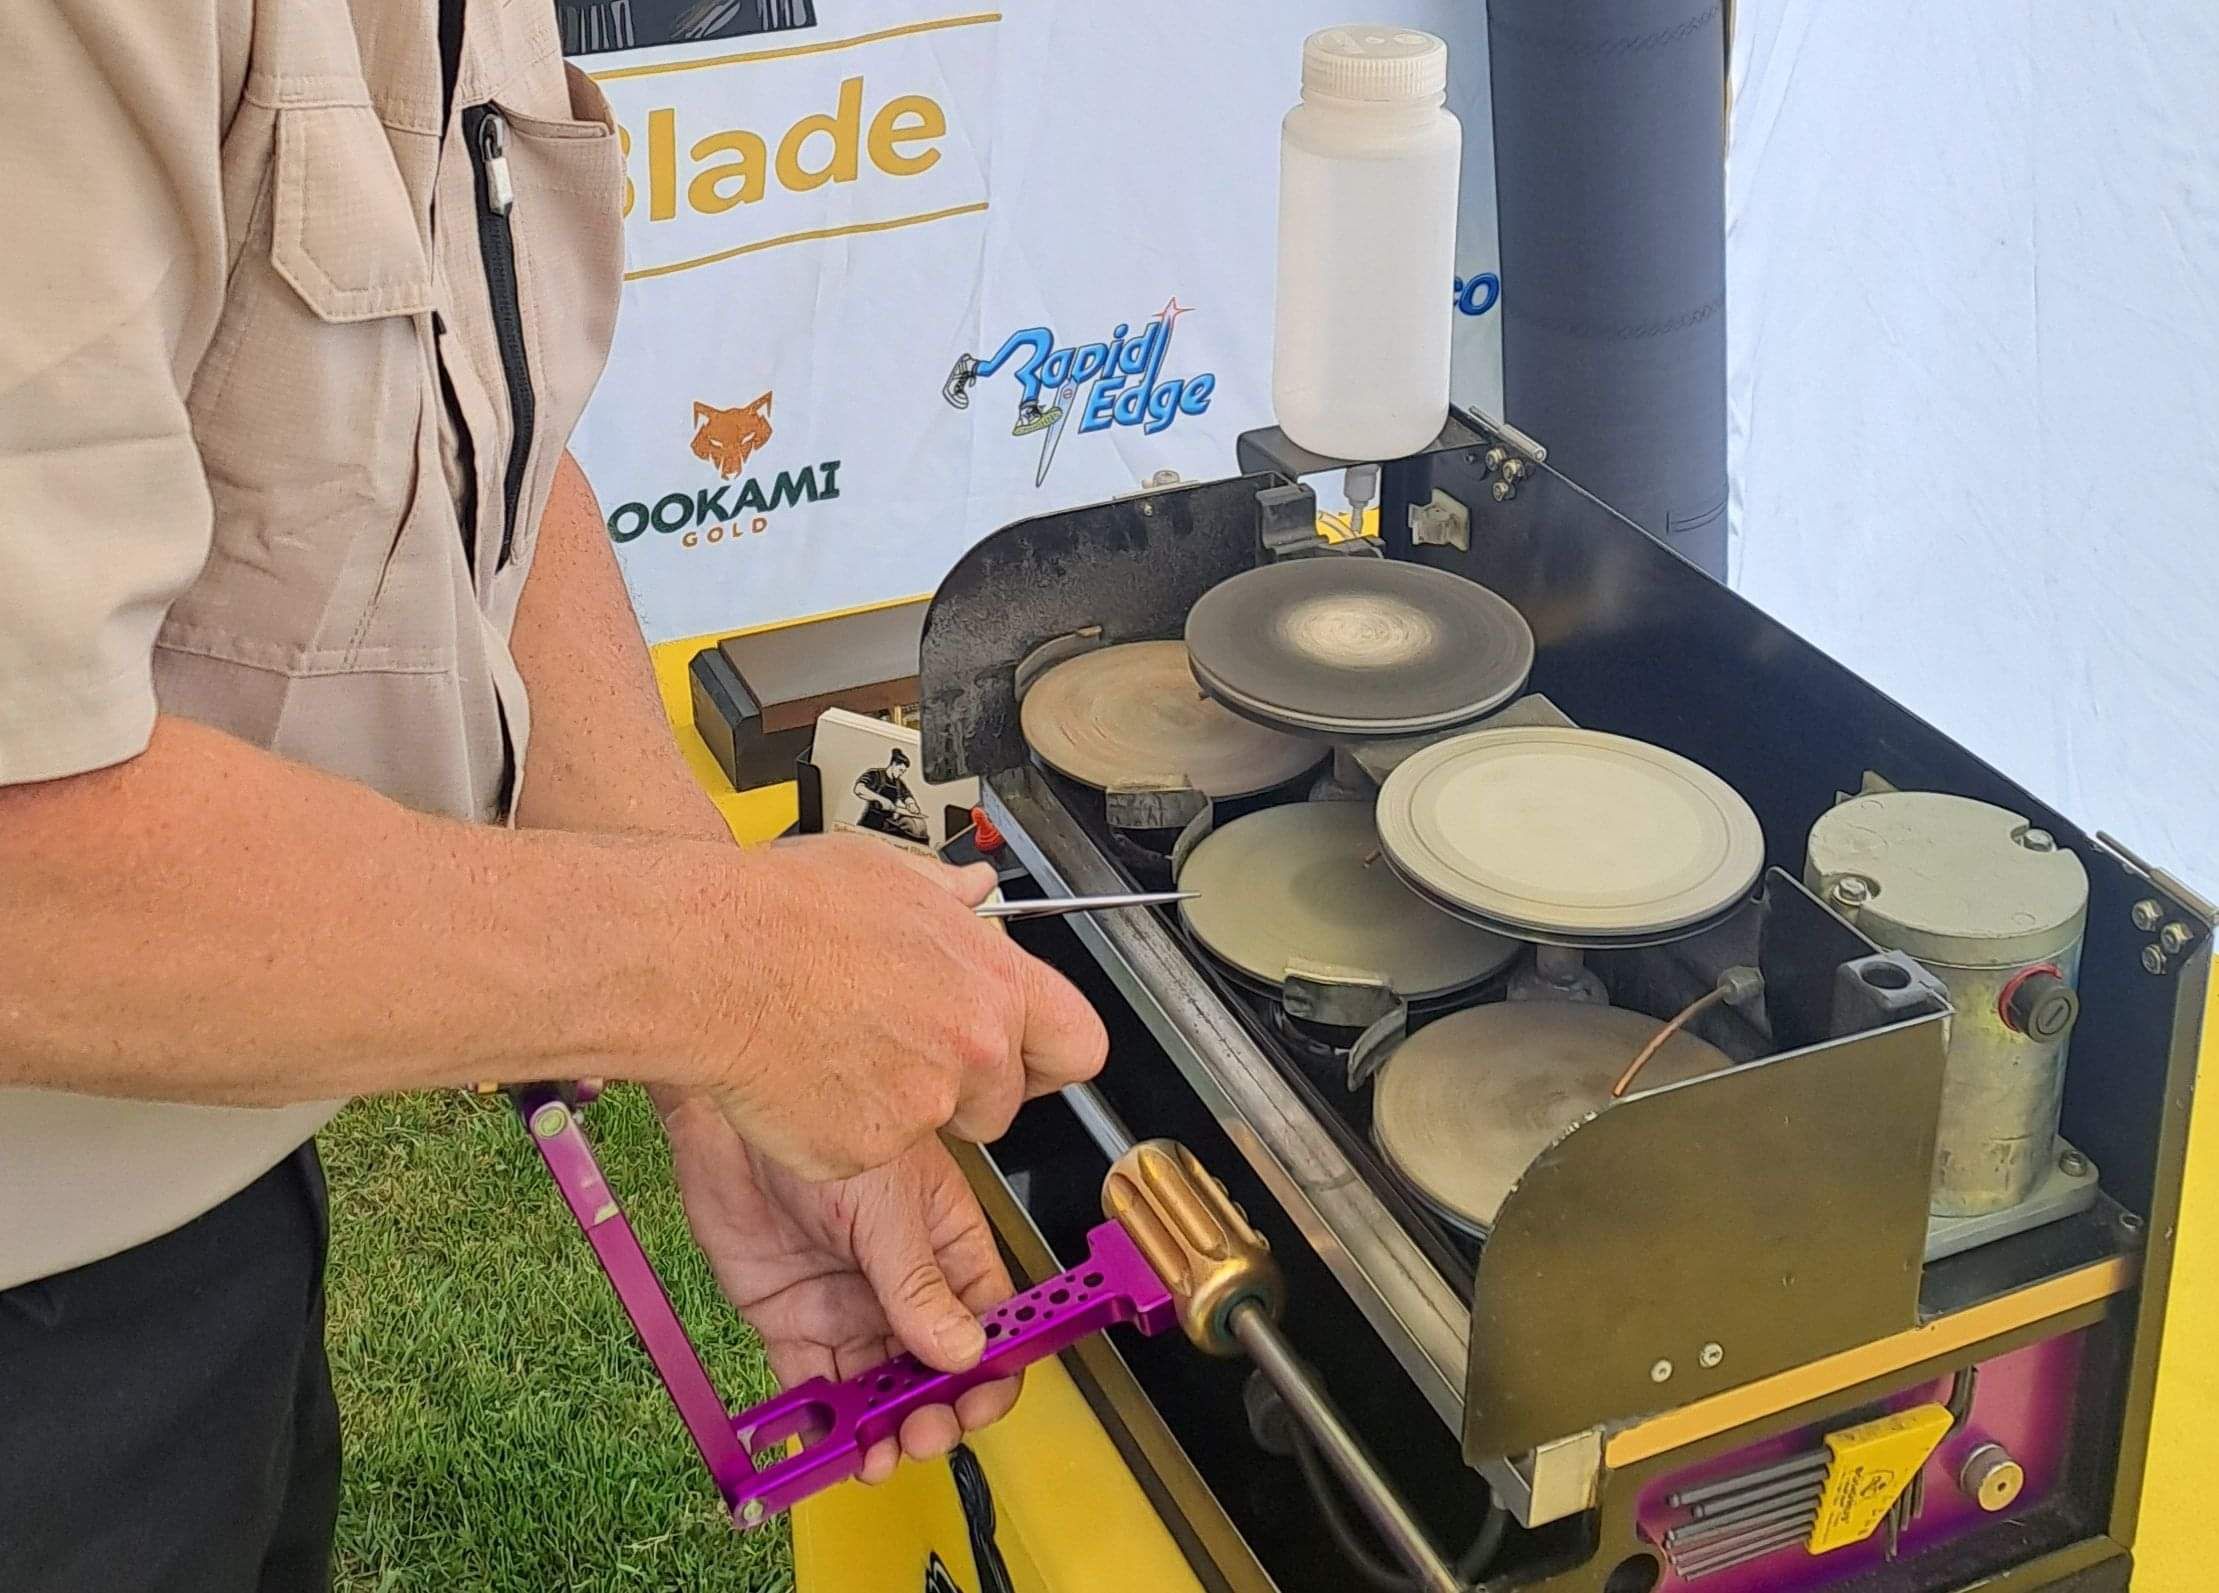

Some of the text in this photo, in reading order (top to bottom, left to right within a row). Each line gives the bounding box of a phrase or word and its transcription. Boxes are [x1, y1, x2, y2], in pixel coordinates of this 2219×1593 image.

[958, 320, 1168, 416] Rapid
[1078, 373, 1216, 436] Edge
[607, 460, 841, 543] OOKAMI
[682, 516, 768, 547] GOLD
